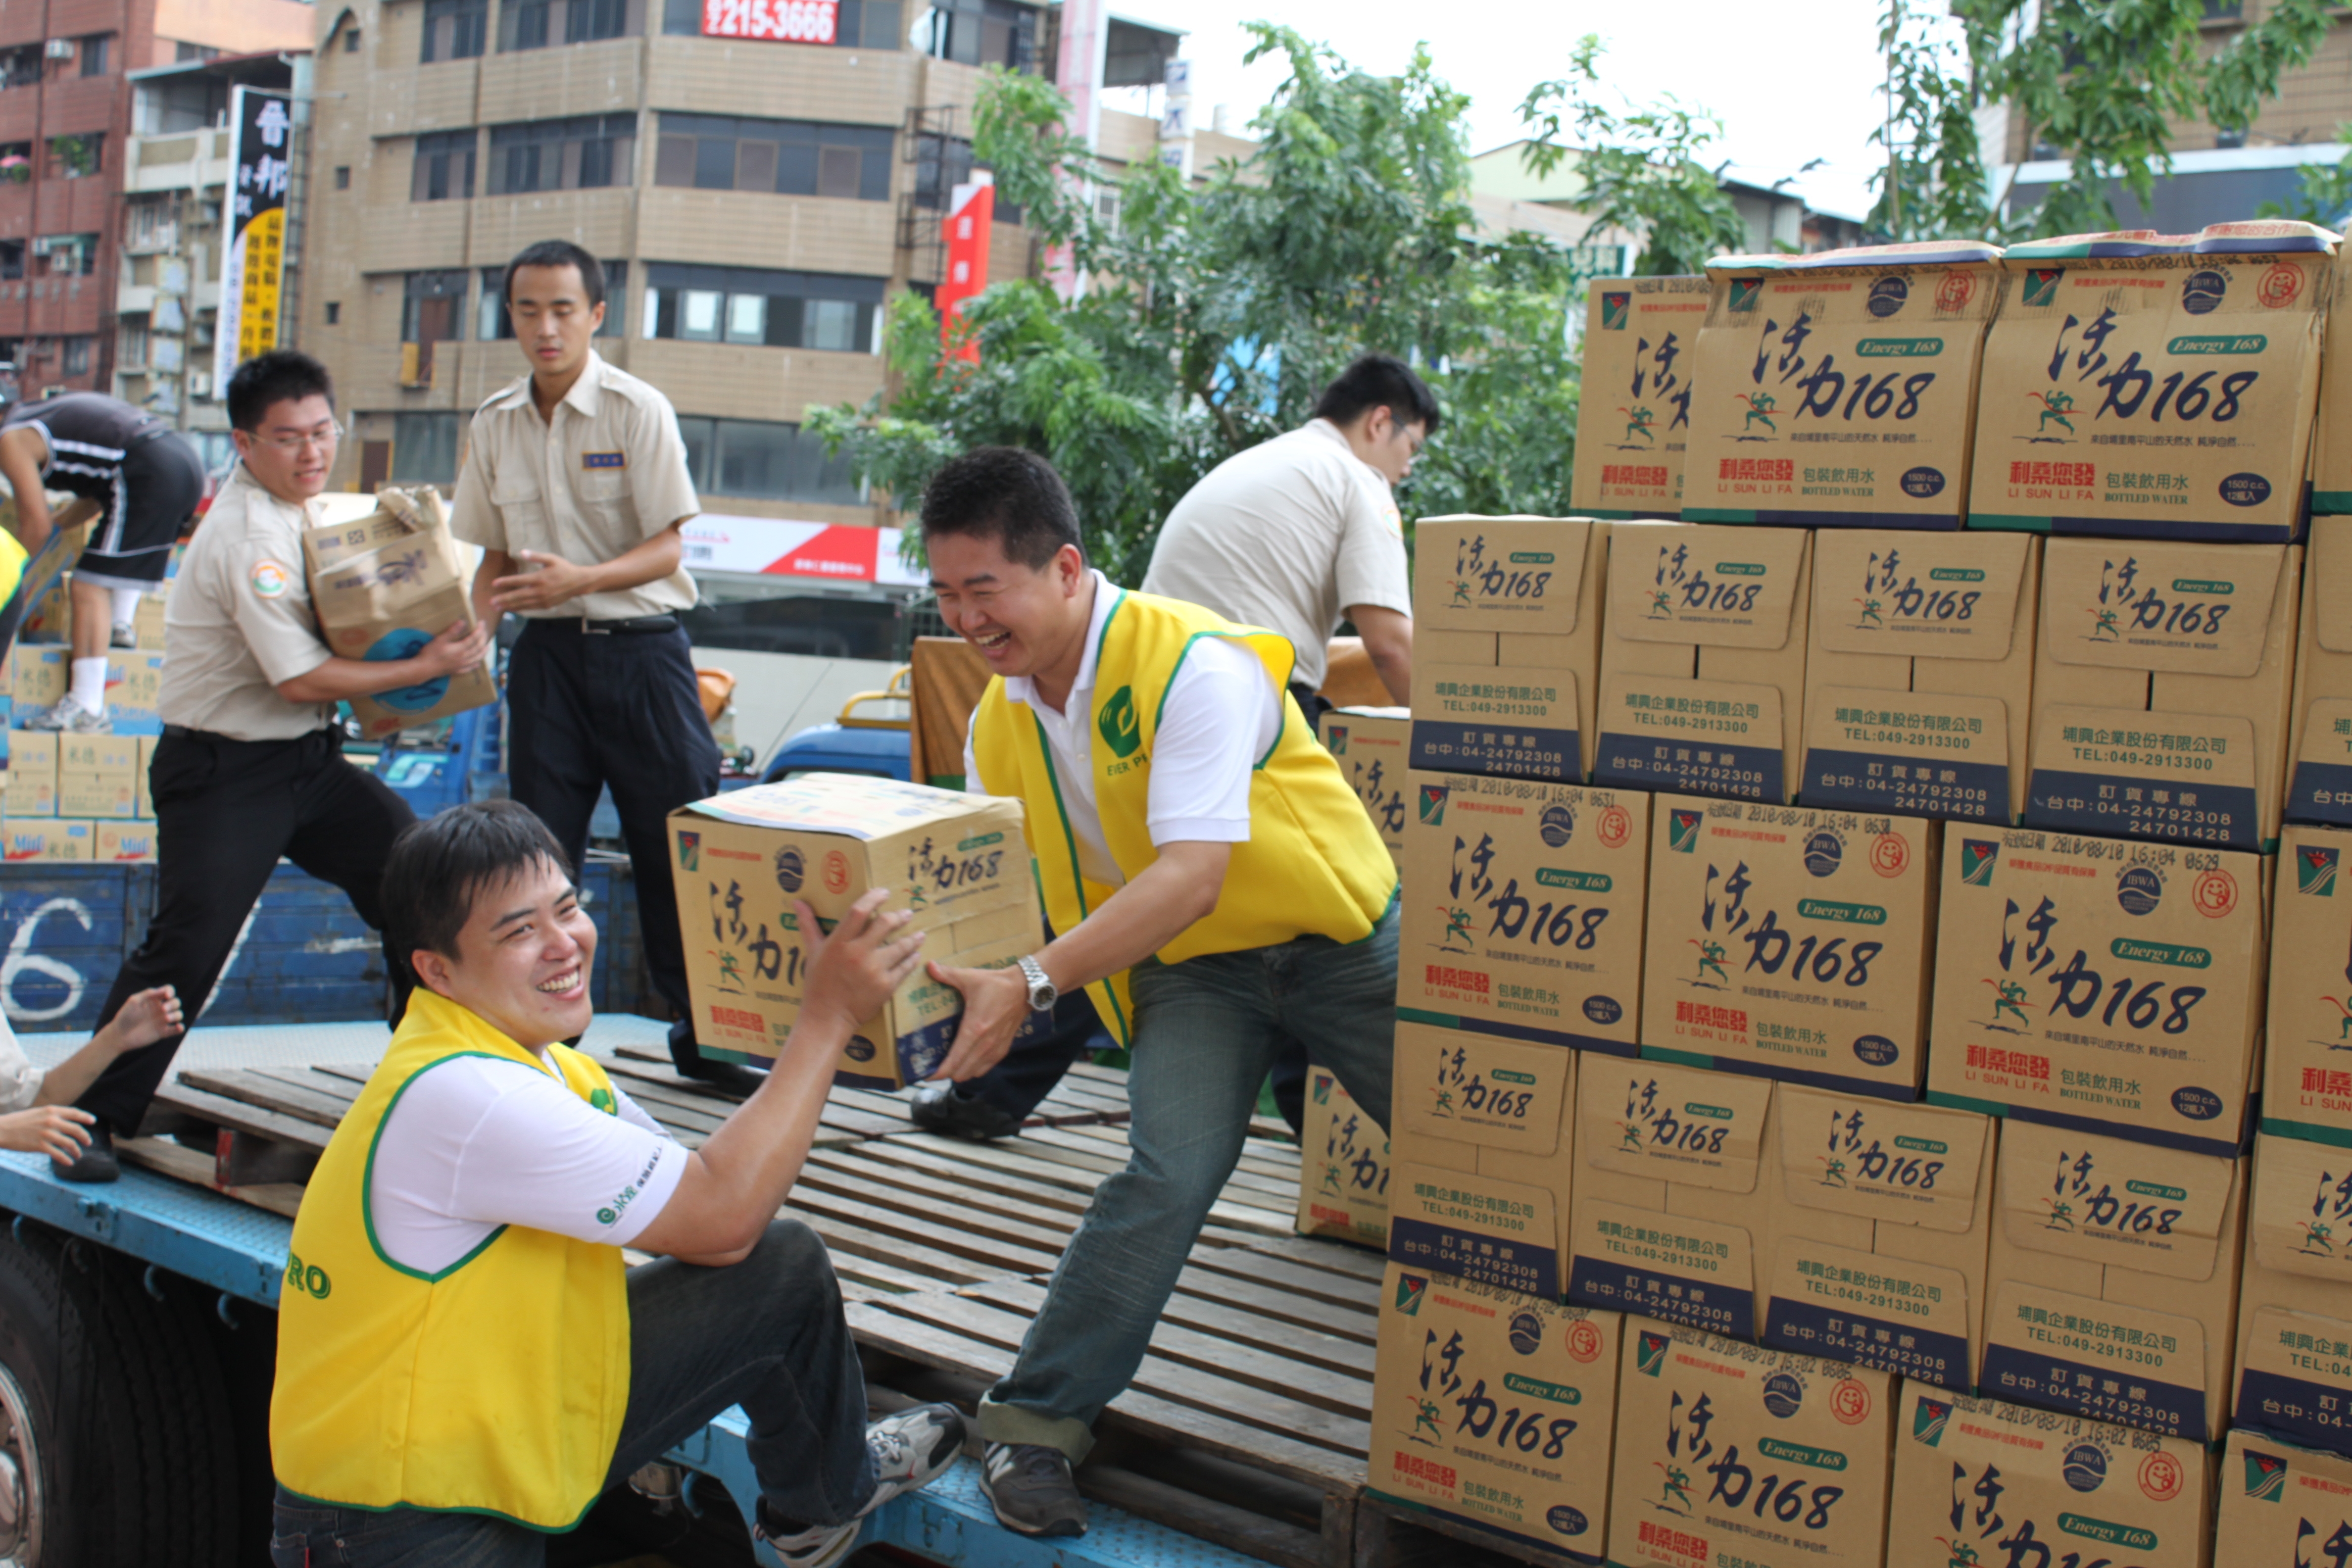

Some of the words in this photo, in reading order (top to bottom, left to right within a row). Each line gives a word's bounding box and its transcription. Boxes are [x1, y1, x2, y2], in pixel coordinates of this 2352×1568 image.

[1862, 342, 1911, 355] Energy
[1912, 341, 1938, 352] 168
[2172, 339, 2229, 353] Energy
[2231, 339, 2261, 350] 168
[2051, 307, 2258, 421] 活力168
[2009, 461, 2096, 487] 利桑您發
[2105, 472, 2190, 490] 包裝飲用水
[2227, 480, 2249, 489] 1500
[1717, 483, 1727, 493] LI
[1733, 484, 1757, 493] SUN
[1762, 484, 1771, 493] LI
[1777, 485, 1793, 494] FA
[2008, 488, 2018, 498] LI
[2025, 489, 2053, 500] SUN
[2058, 490, 2070, 500] LI
[2077, 490, 2095, 501] FA
[2105, 492, 2149, 503] BOTTLED
[2151, 494, 2188, 505] WATER
[1656, 544, 1762, 611] 活力168
[1865, 550, 1981, 619] 活力168
[2099, 558, 2230, 634] 活力168
[1634, 712, 1747, 733] TEL:049-2913300
[1845, 728, 1970, 749] TEL:049-2913300
[2073, 747, 2212, 770] TEL:049-2913300
[1679, 778, 1761, 797] 24701428
[1822, 773, 1987, 801] 台中:04-24792308
[1895, 796, 1985, 816] 24701428
[2048, 795, 2231, 826] 台中:04-24792308
[2129, 820, 2230, 841] 24701428
[1451, 833, 1608, 949] 活力168
[1540, 871, 1582, 888] Energy
[1585, 876, 1607, 888] 168
[2126, 874, 2156, 888] IBWA
[1702, 862, 1882, 986] 活力168
[1804, 902, 1852, 920] Energy
[1856, 908, 1880, 921] 168
[1, 898, 93, 1022] 6
[2000, 897, 2205, 1033] 活力168
[2117, 941, 2173, 963] Energy
[2176, 950, 2205, 965] 168
[1498, 982, 1561, 1005] 包裝飲用水
[1675, 1000, 1748, 1032] 利桑您發
[1675, 1025, 1684, 1034] LI
[1690, 1027, 1713, 1039] SUN
[1717, 1031, 1727, 1041] LI
[1733, 1034, 1748, 1045] FA
[1756, 1021, 1827, 1046] 包裝飲用水
[1757, 1039, 1794, 1053] BOTTLED
[1796, 1045, 1827, 1058] WATER
[1966, 1044, 2051, 1080] 利桑您發
[1965, 1070, 1976, 1081] LI
[1983, 1073, 2009, 1087] SUN
[2014, 1078, 2026, 1090] LI
[2033, 1082, 2050, 1094] FA
[2059, 1068, 2142, 1097] 包裝飲用水
[2059, 1088, 2103, 1104] BOTTLED
[2105, 1095, 2141, 1110] WATER
[2179, 1091, 2201, 1103] 1500
[1626, 1079, 1730, 1153] 活力168
[1829, 1110, 1943, 1187] 活力168
[2055, 1152, 2181, 1236] 活力168
[1606, 1239, 1717, 1272] TEL:049-2913300
[1806, 1279, 1929, 1316] TEL:049-2913300
[1783, 1323, 1945, 1371] 台中:04-24792308
[2027, 1326, 2163, 1368] TEL:049-2913300
[1509, 1375, 1551, 1397] Energy
[1553, 1387, 1575, 1402] 168
[2001, 1371, 2180, 1425] 台中:04-24792308
[1667, 1392, 1843, 1529] 活力168
[1766, 1439, 1814, 1462] Energy
[1817, 1451, 1842, 1467] 168
[2071, 1448, 2100, 1466] IBWA
[2064, 1516, 2118, 1541] Energy
[2122, 1530, 2151, 1547] 168
